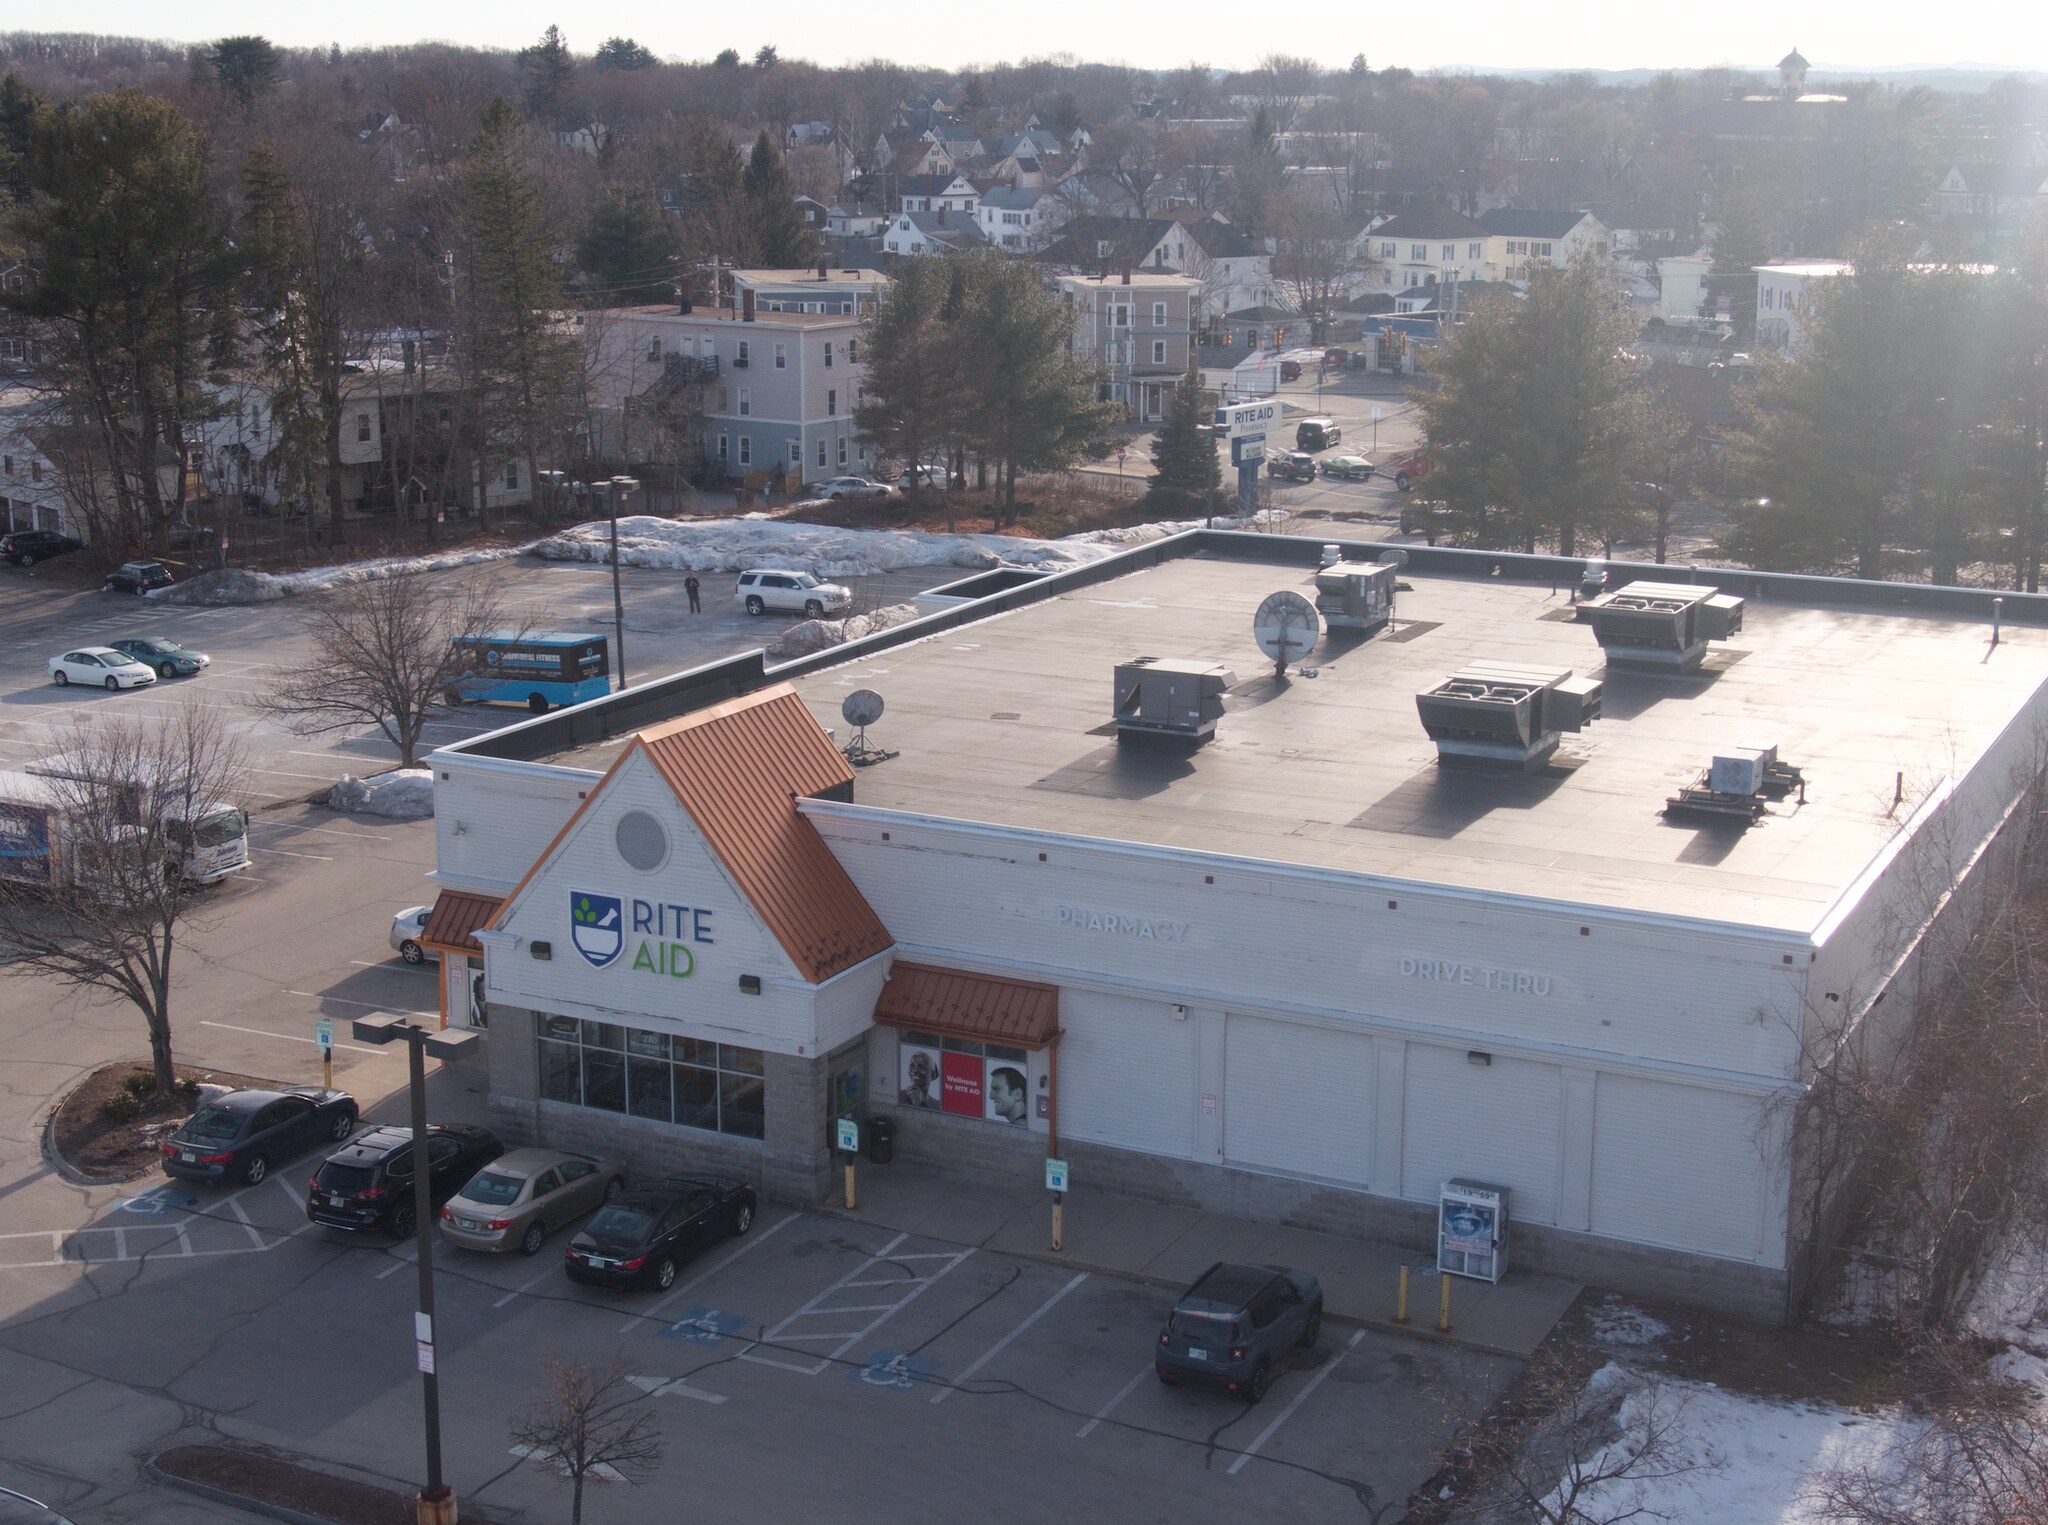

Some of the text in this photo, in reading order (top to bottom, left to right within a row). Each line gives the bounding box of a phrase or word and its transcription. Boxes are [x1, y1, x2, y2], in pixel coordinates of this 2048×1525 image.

[1235, 407, 1274, 424] RITE AID
[633, 899, 714, 944] RITE
[1056, 905, 1188, 942] PHARMACY
[632, 939, 695, 978] AID
[1400, 956, 1551, 997] DRIVE THRU
[945, 1083, 953, 1091] by
[954, 1085, 968, 1093] RITE
[946, 1075, 978, 1087] Wellness
